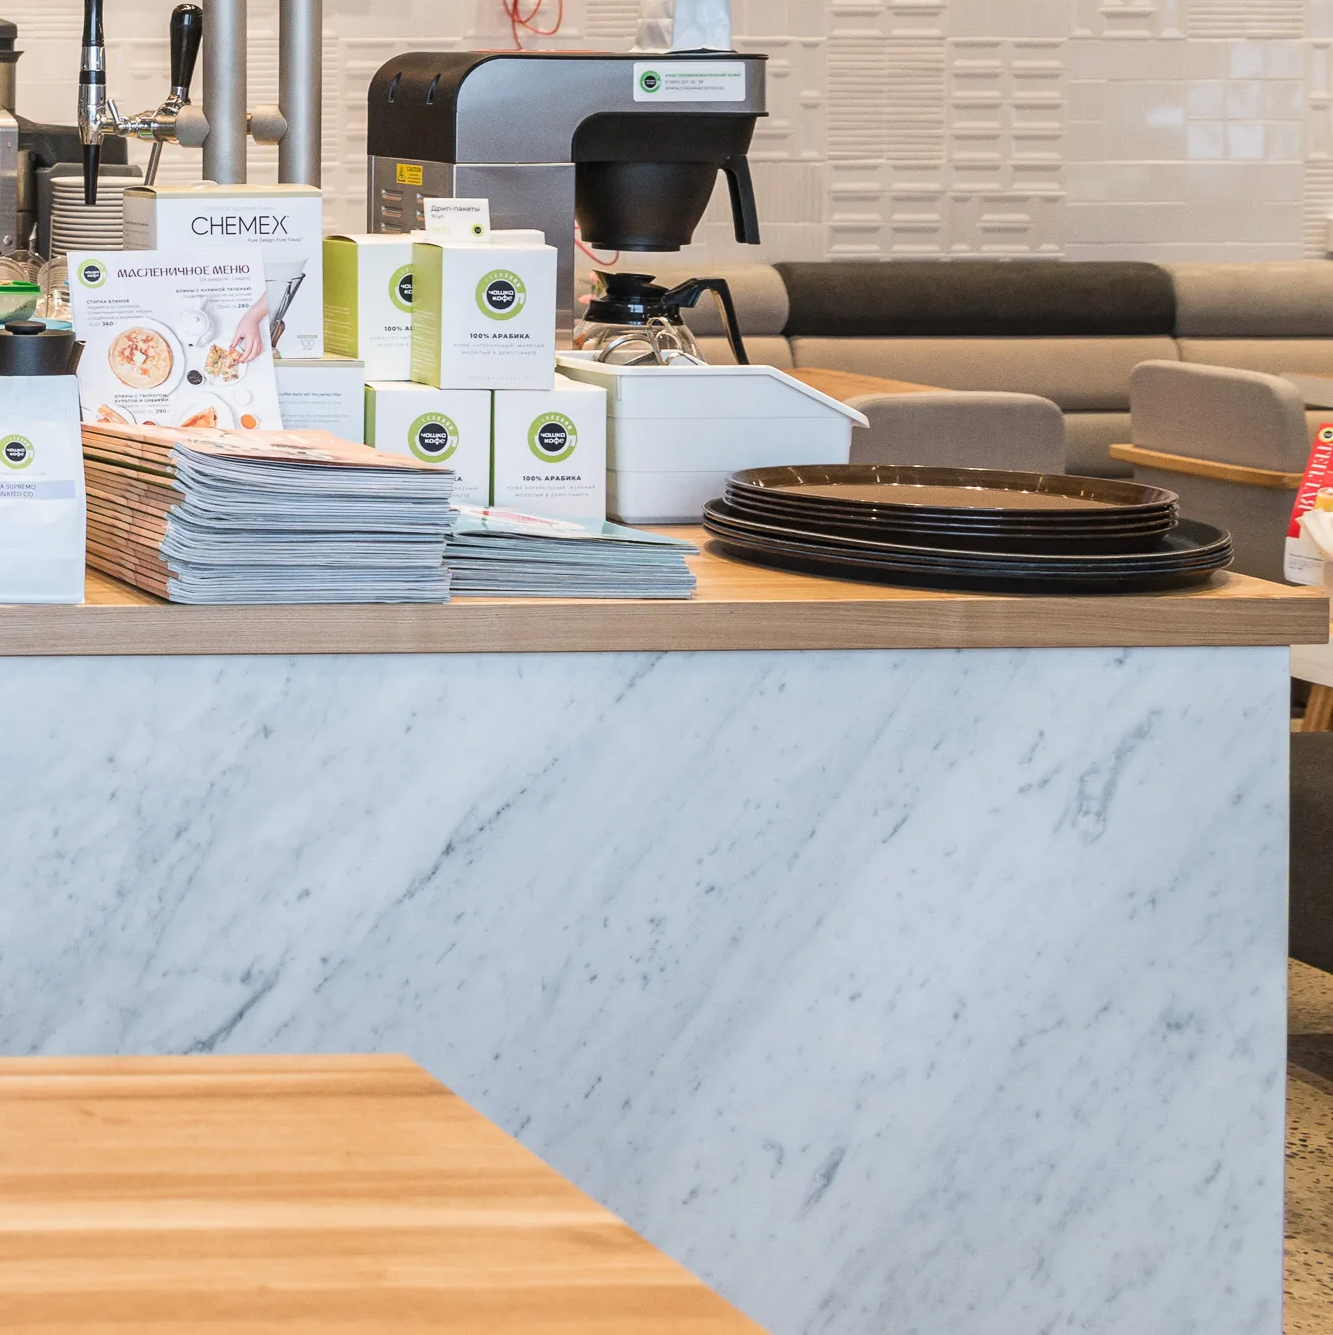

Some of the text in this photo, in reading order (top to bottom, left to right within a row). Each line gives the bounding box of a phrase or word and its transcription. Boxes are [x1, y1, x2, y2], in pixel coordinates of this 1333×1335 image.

[431, 205, 481, 213] Дрип-пакеты
[191, 215, 289, 235] CHEMEX
[117, 264, 250, 278] МАСЛЕНИЧНОЕ МЕНЮ
[492, 295, 513, 303] кофе
[543, 437, 565, 445] кофе
[5, 482, 37, 491] SUPREMO
[22, 490, 33, 498] CO
